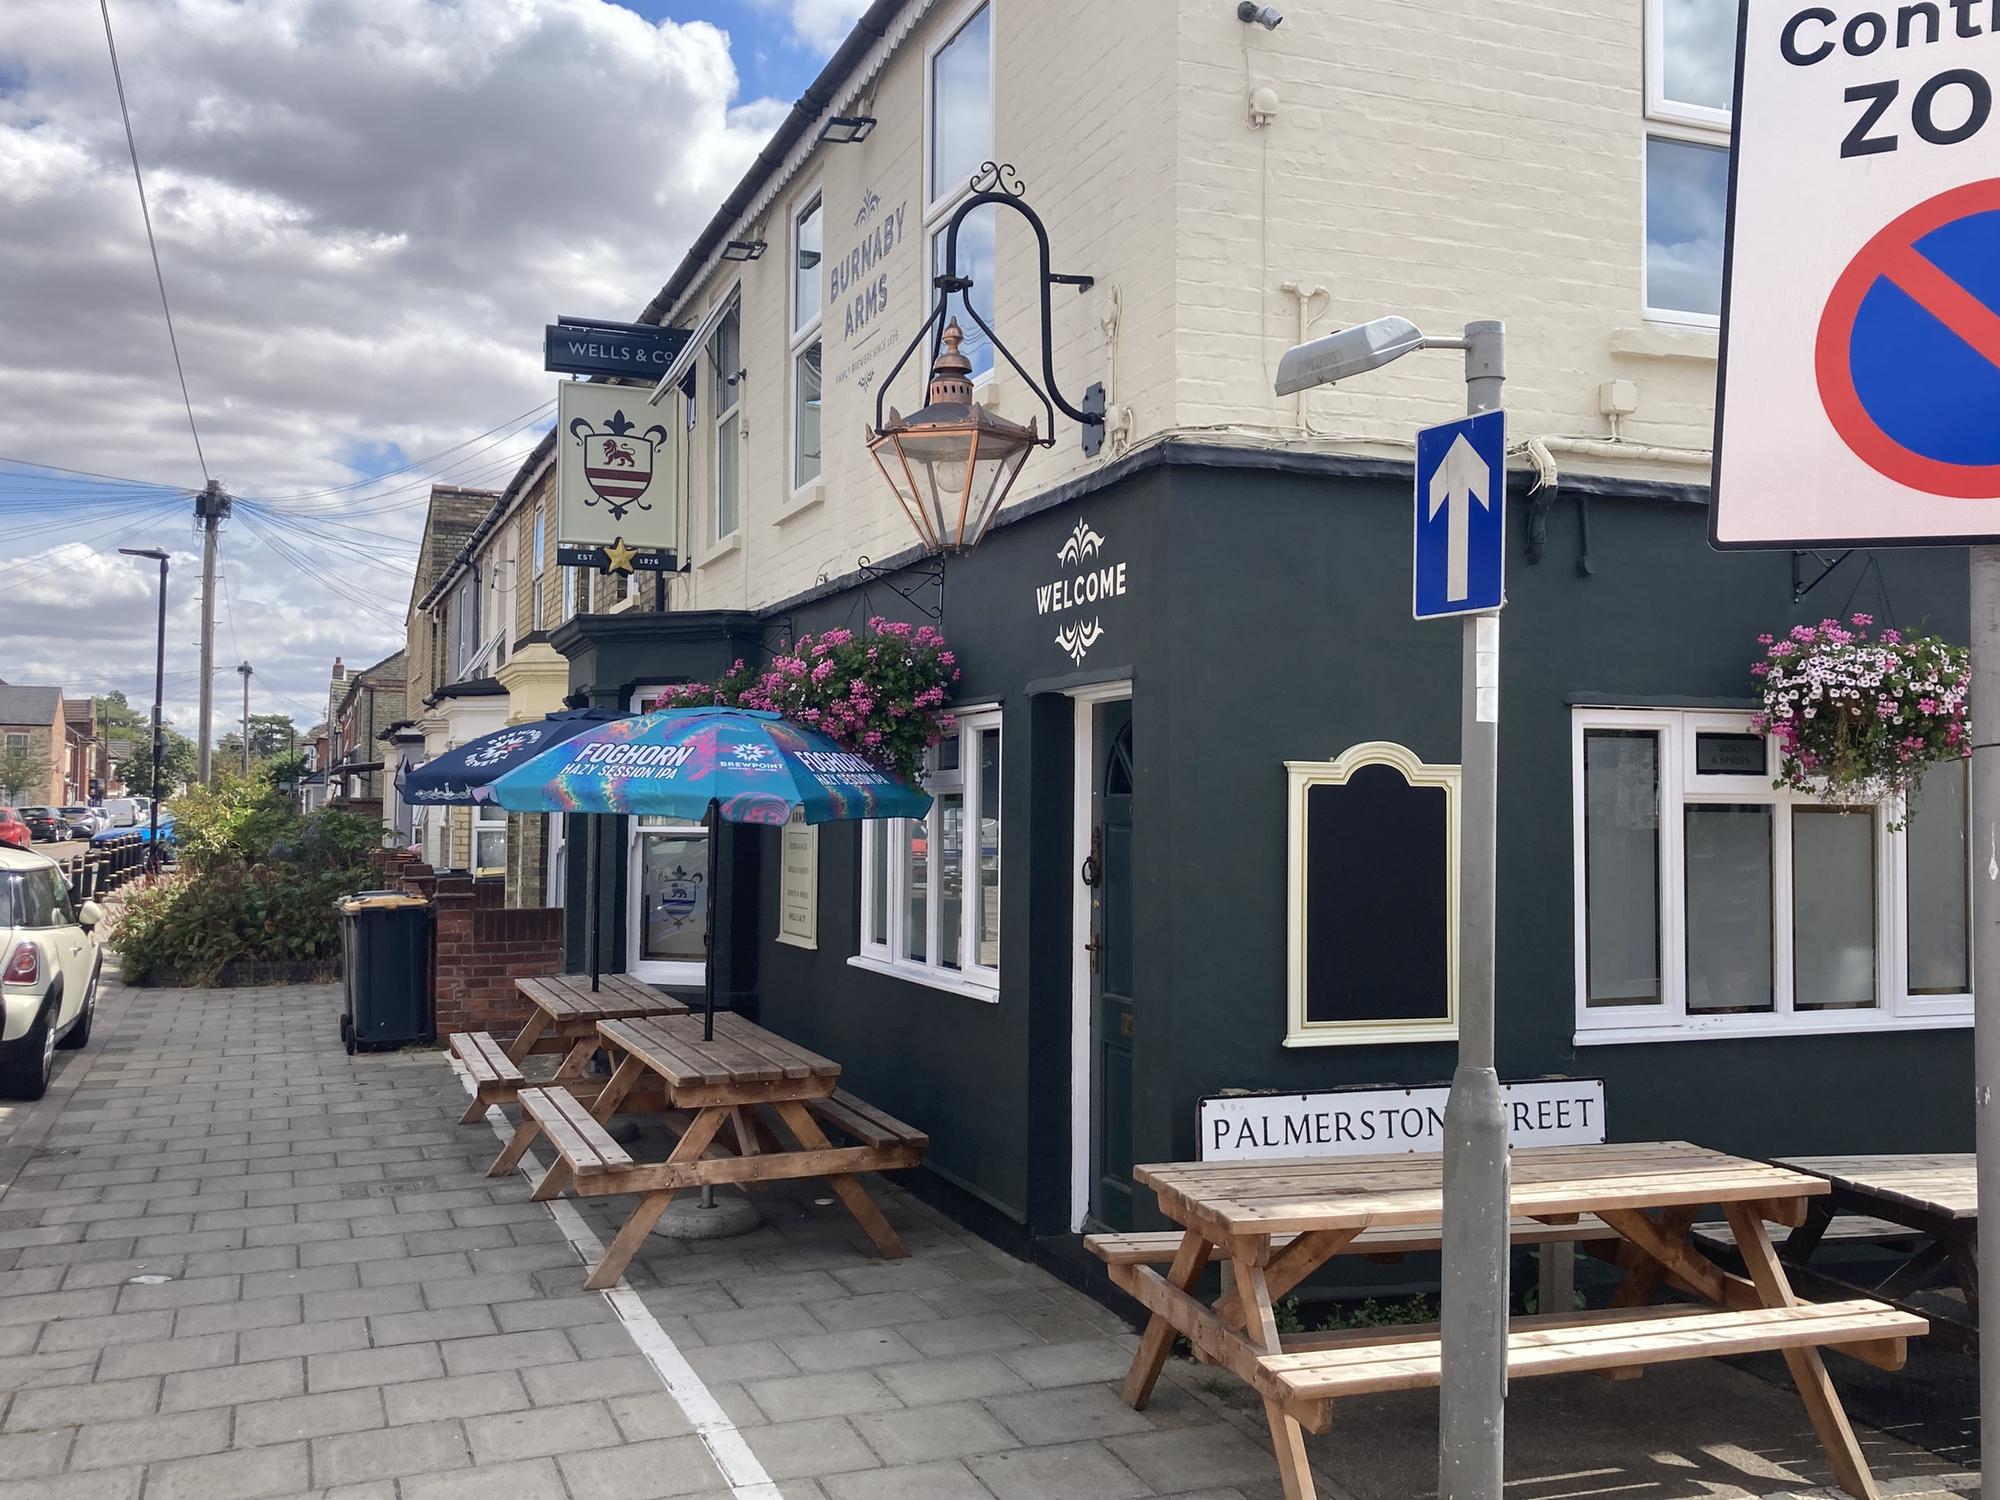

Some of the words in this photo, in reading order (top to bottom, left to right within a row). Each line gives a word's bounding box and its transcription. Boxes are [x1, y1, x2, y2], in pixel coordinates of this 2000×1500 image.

[1780, 0, 2000, 66] Cont
[831, 200, 907, 304] BURNABY
[844, 272, 888, 342] ARMS
[568, 341, 630, 360] WELLS
[636, 349, 647, 362] &
[1036, 562, 1127, 615] WELCOME
[574, 743, 695, 767] FOGHORN
[720, 761, 784, 770] BREWPOINT
[560, 763, 599, 776] HAZY
[598, 765, 655, 779] SESSION
[654, 767, 679, 780] IPA
[813, 774, 838, 786] HAZY
[836, 774, 874, 786] SESSION
[872, 774, 890, 785] IPA
